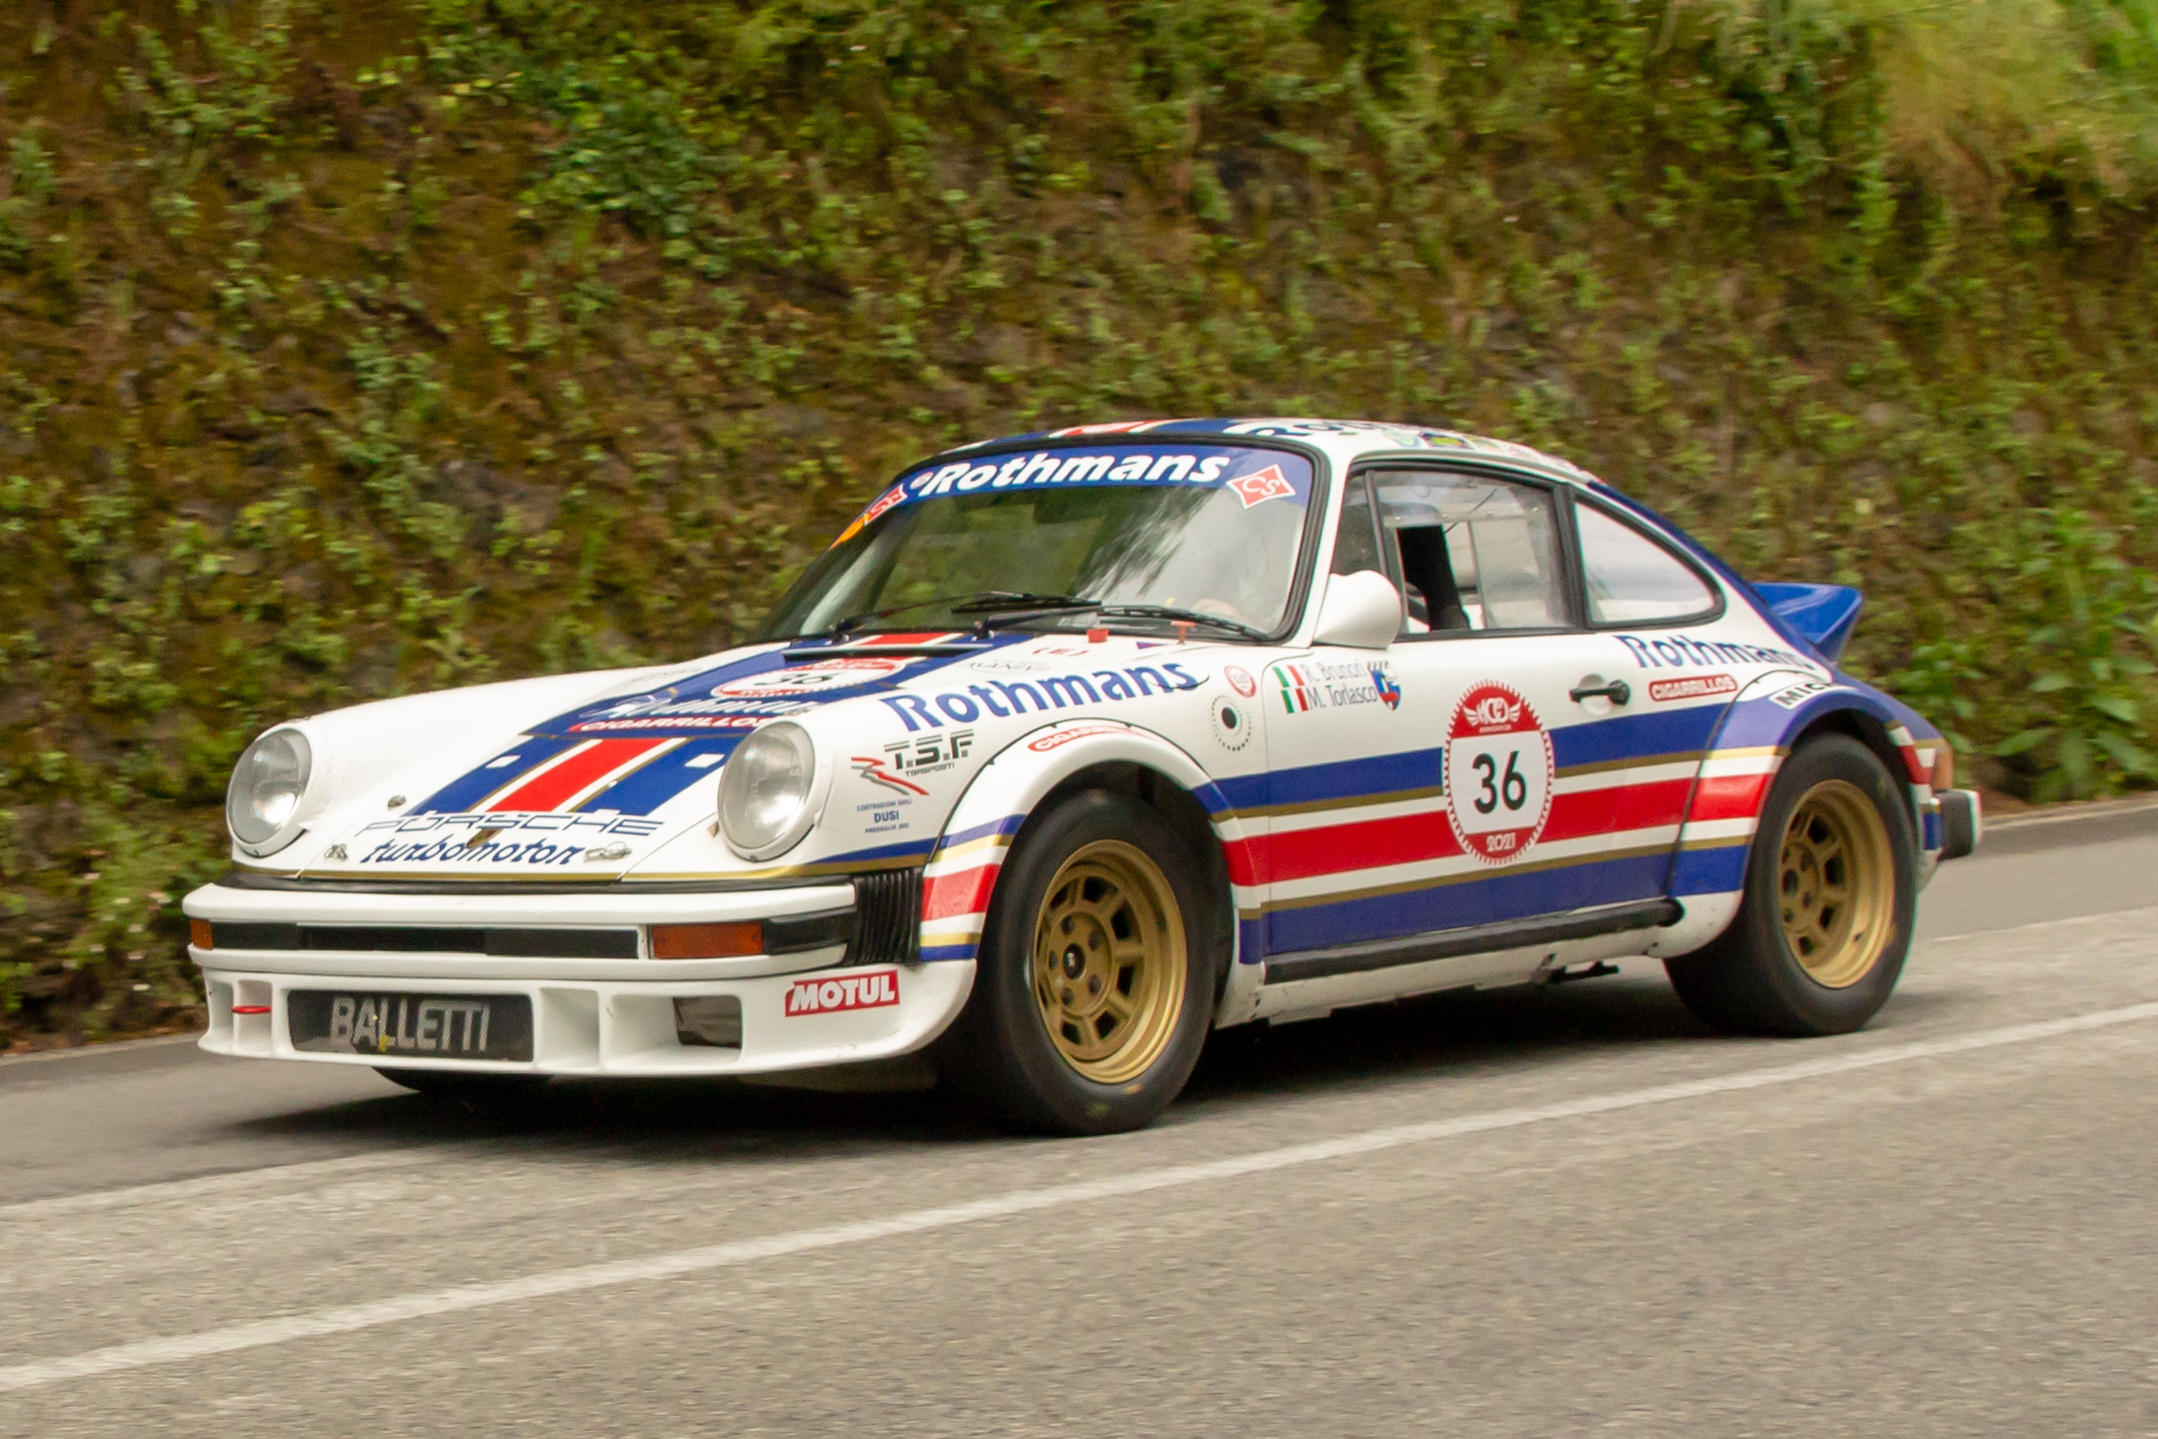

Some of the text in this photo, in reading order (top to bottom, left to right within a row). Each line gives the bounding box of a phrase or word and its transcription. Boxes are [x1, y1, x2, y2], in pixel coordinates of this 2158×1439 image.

[918, 453, 1230, 497] Rothmans
[1241, 475, 1282, 496] CS
[881, 663, 1199, 732] Rothmans
[1306, 683, 1378, 709] M. Torlasco
[1651, 676, 1736, 699] CIGARRILLOS
[1472, 750, 1527, 814] 36
[355, 811, 665, 837] PORSCHE
[874, 810, 900, 823] DUSI
[360, 834, 586, 865] turbomotor
[1486, 833, 1516, 852] 2021
[789, 974, 896, 1012] MOTUL
[329, 997, 491, 1051] BALLETTI
